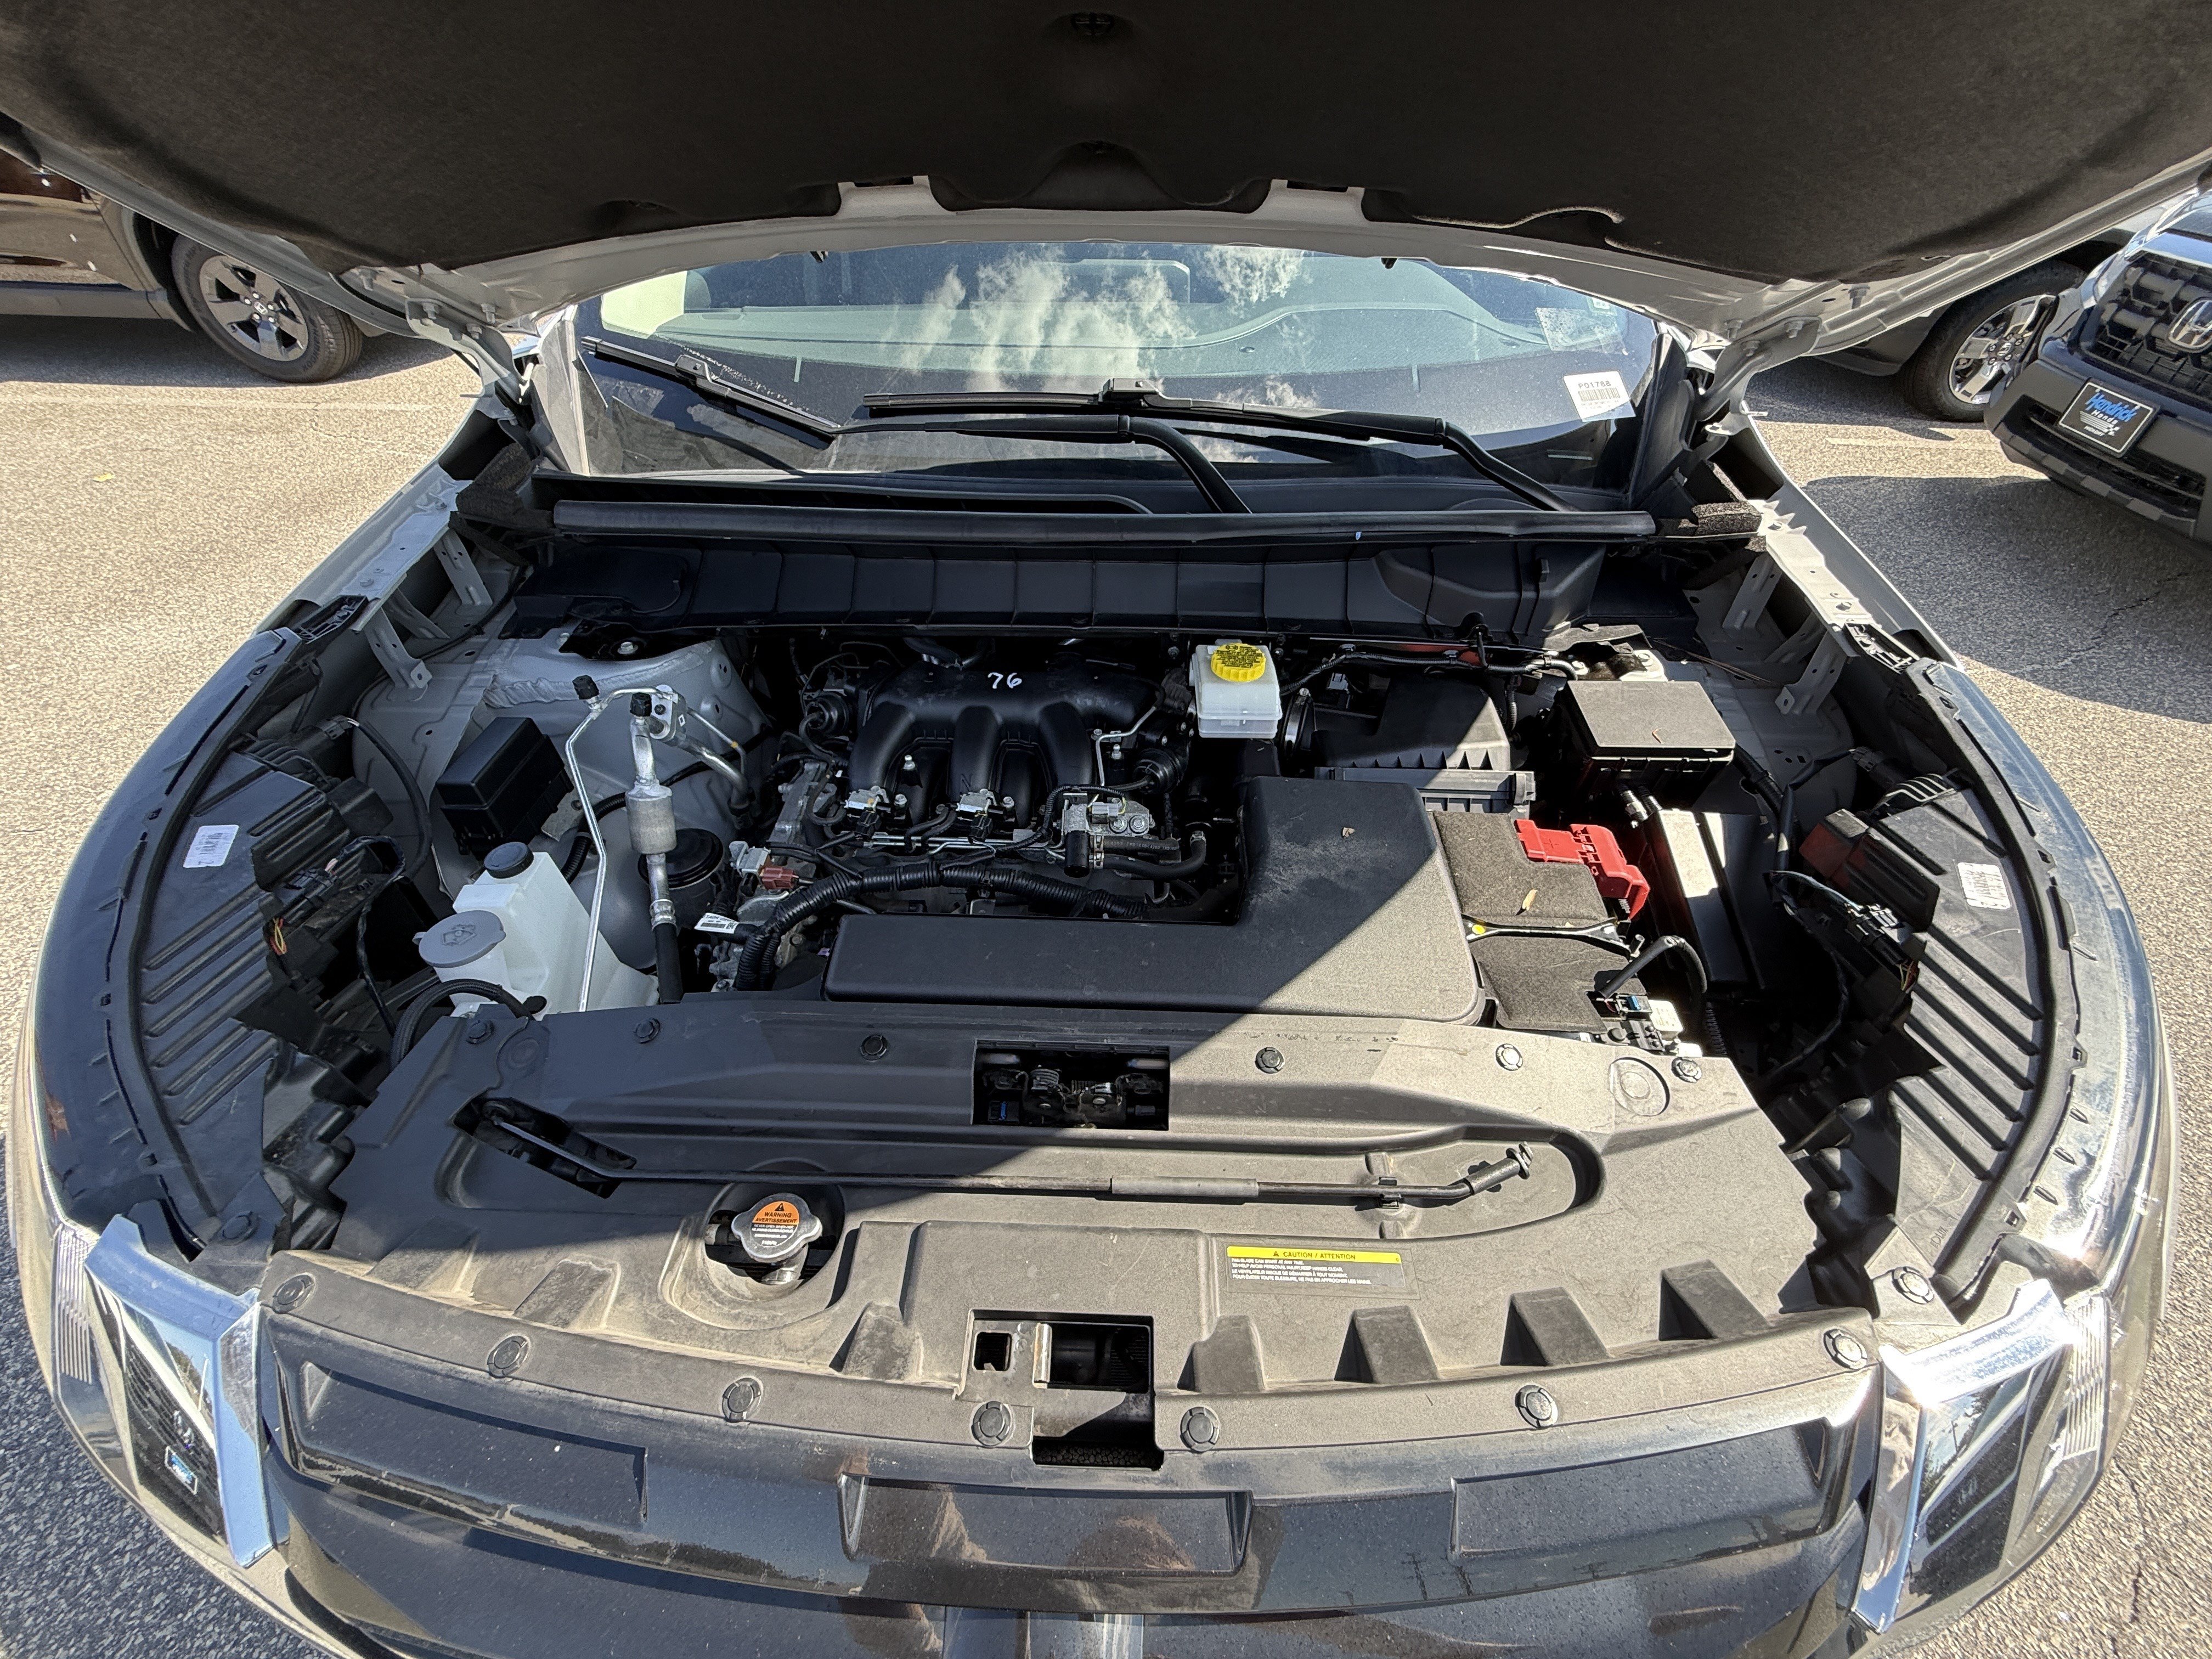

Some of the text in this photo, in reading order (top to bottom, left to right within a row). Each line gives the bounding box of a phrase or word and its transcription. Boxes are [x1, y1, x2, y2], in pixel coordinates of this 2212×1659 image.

[1578, 380, 1611, 388] P01788
[2085, 392, 2137, 422] Hendrick
[2091, 409, 2119, 425] Honda
[988, 672, 1023, 689] 76
